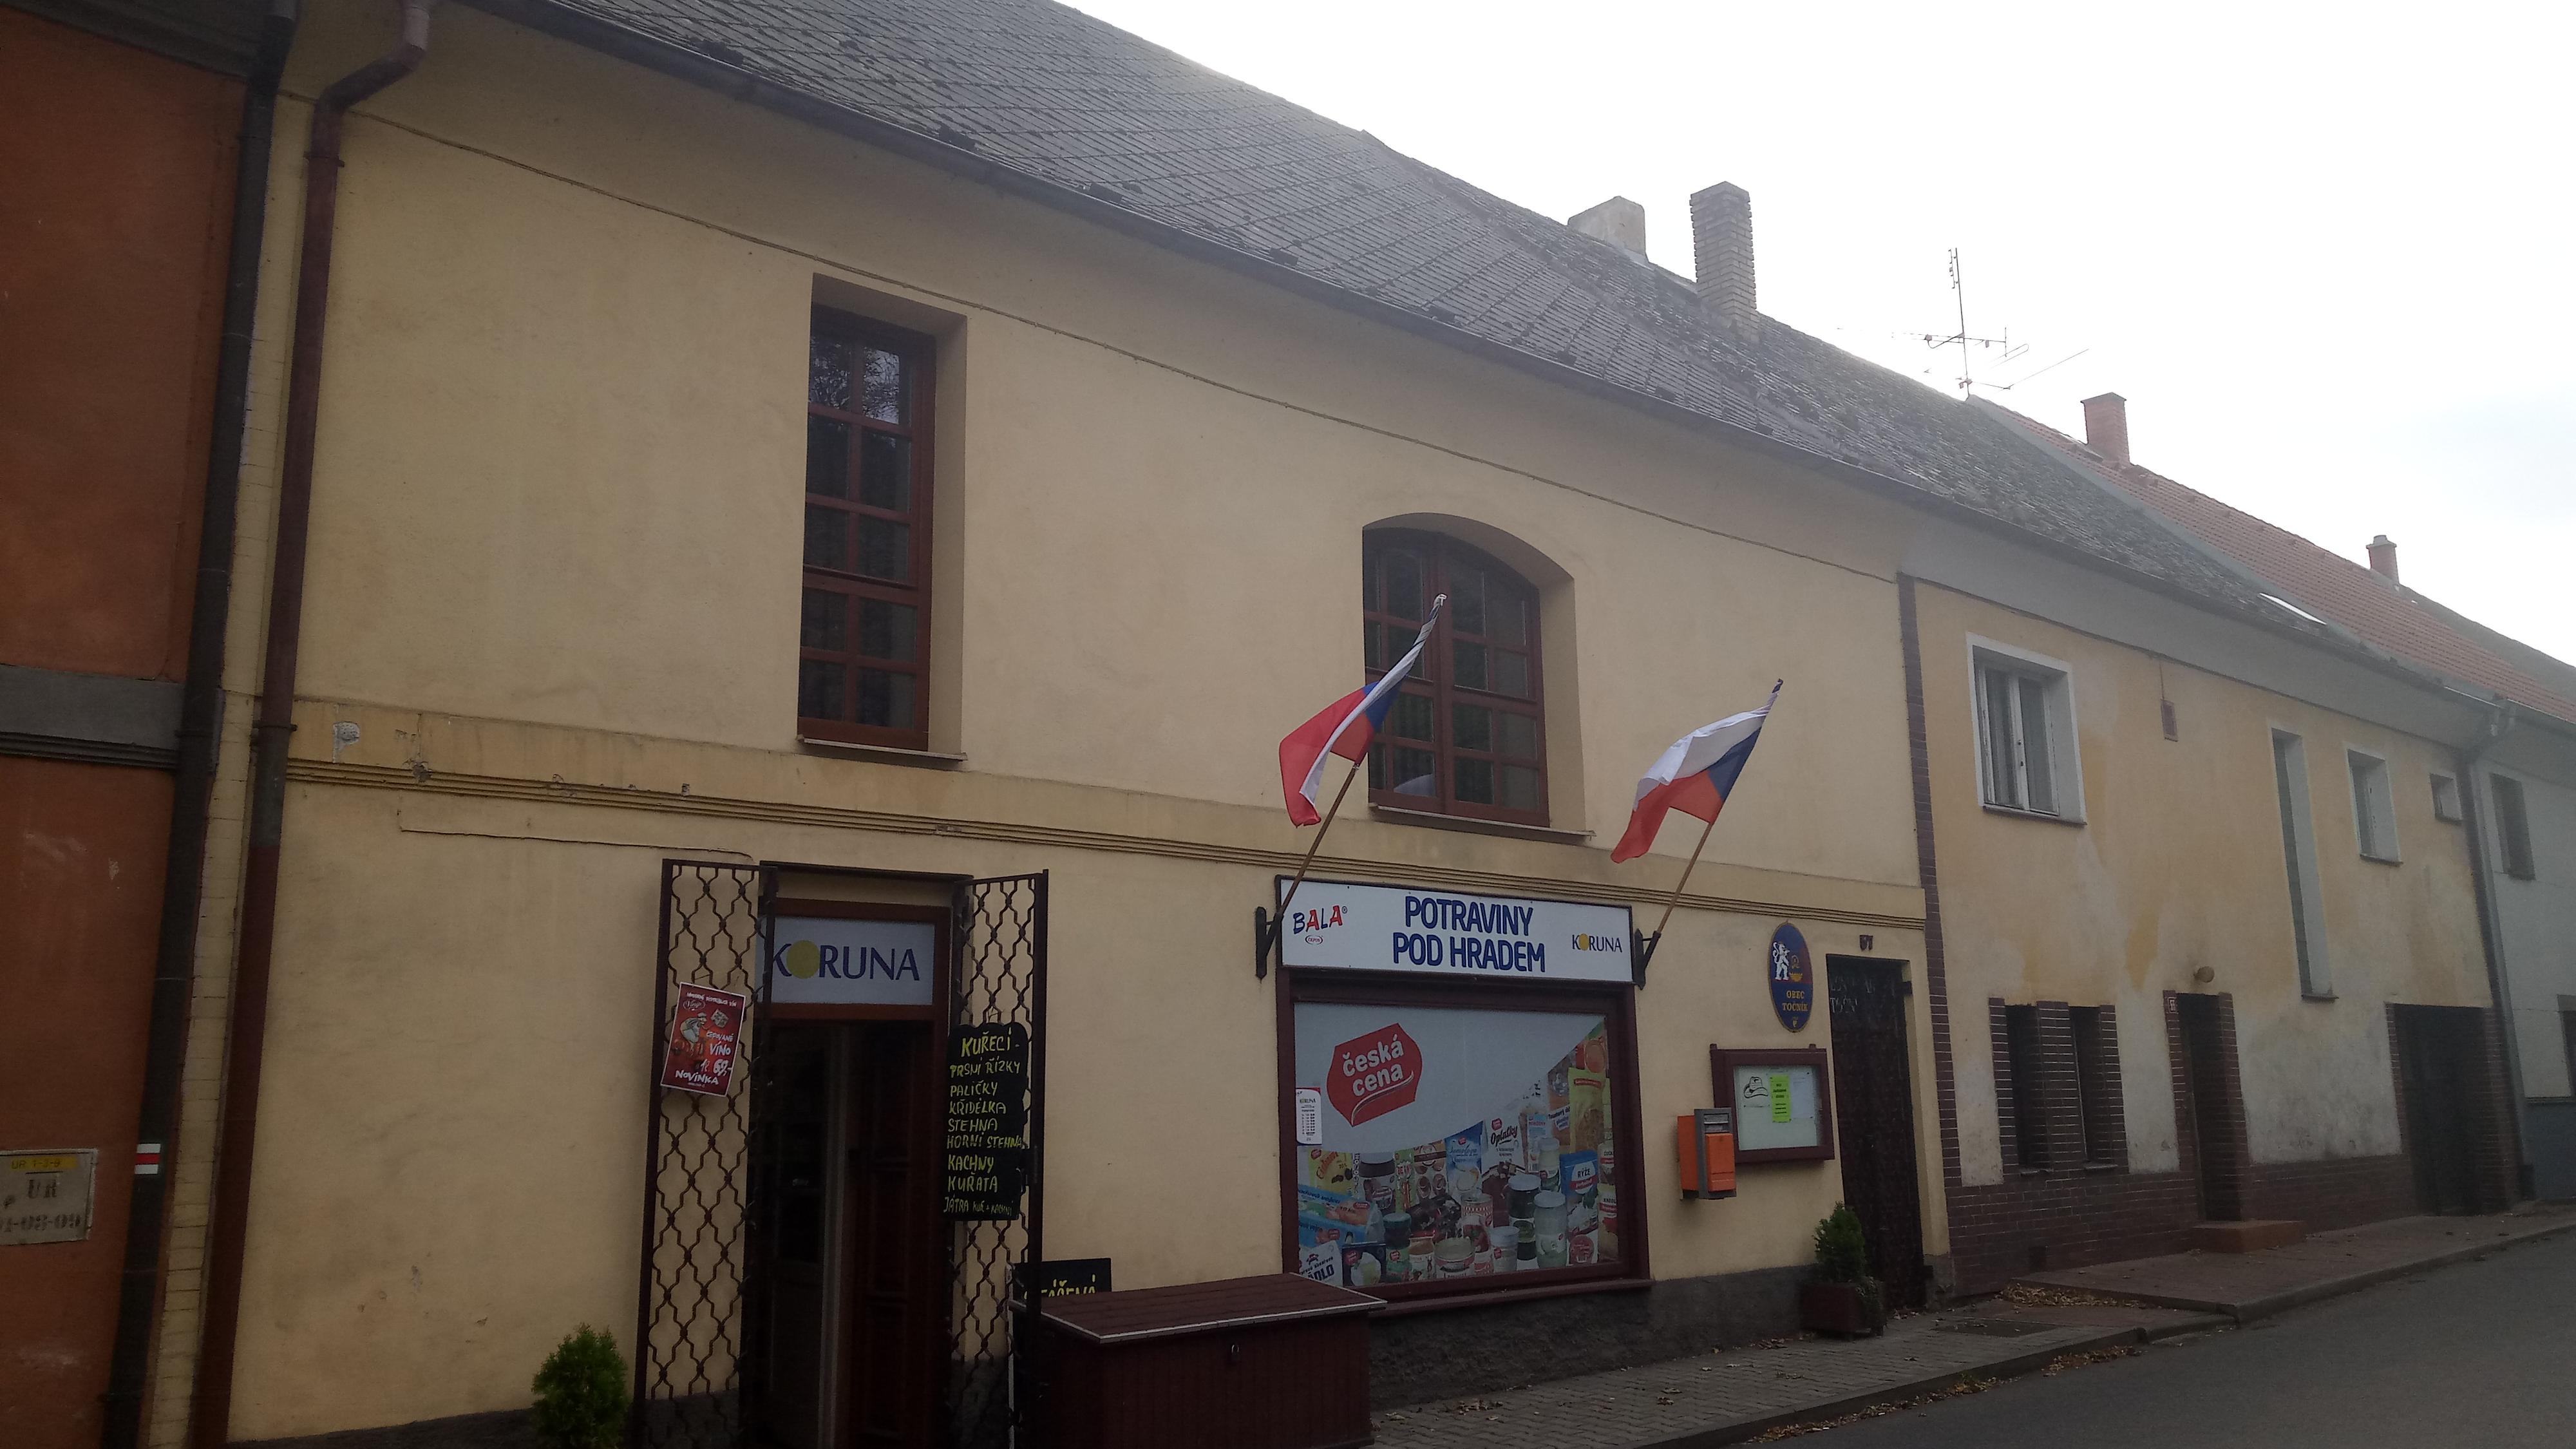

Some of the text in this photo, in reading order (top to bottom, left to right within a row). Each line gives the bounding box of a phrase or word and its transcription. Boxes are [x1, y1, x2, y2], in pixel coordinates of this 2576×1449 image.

[1405, 896, 1533, 936] POTRAVINY
[1393, 932, 1545, 972] POD HRADEM
[1572, 933, 1622, 952] KORUNA
[773, 940, 920, 981] KORUNA
[1786, 990, 1805, 999] OBEC
[710, 1041, 732, 1056] VÍNO
[1342, 1034, 1404, 1077] česká
[985, 1056, 1020, 1074] ŘÍZKY
[675, 1069, 719, 1085] NOVINKA
[1352, 1063, 1403, 1096] cena
[947, 1117, 998, 1133] STEHNA
[986, 1134, 1023, 1149] STEHNA
[1491, 1125, 1518, 1147] Oplatky
[947, 1153, 994, 1174] KACHNY
[947, 1171, 998, 1193] KUŘATA
[943, 1193, 969, 1213] JÁTRA
